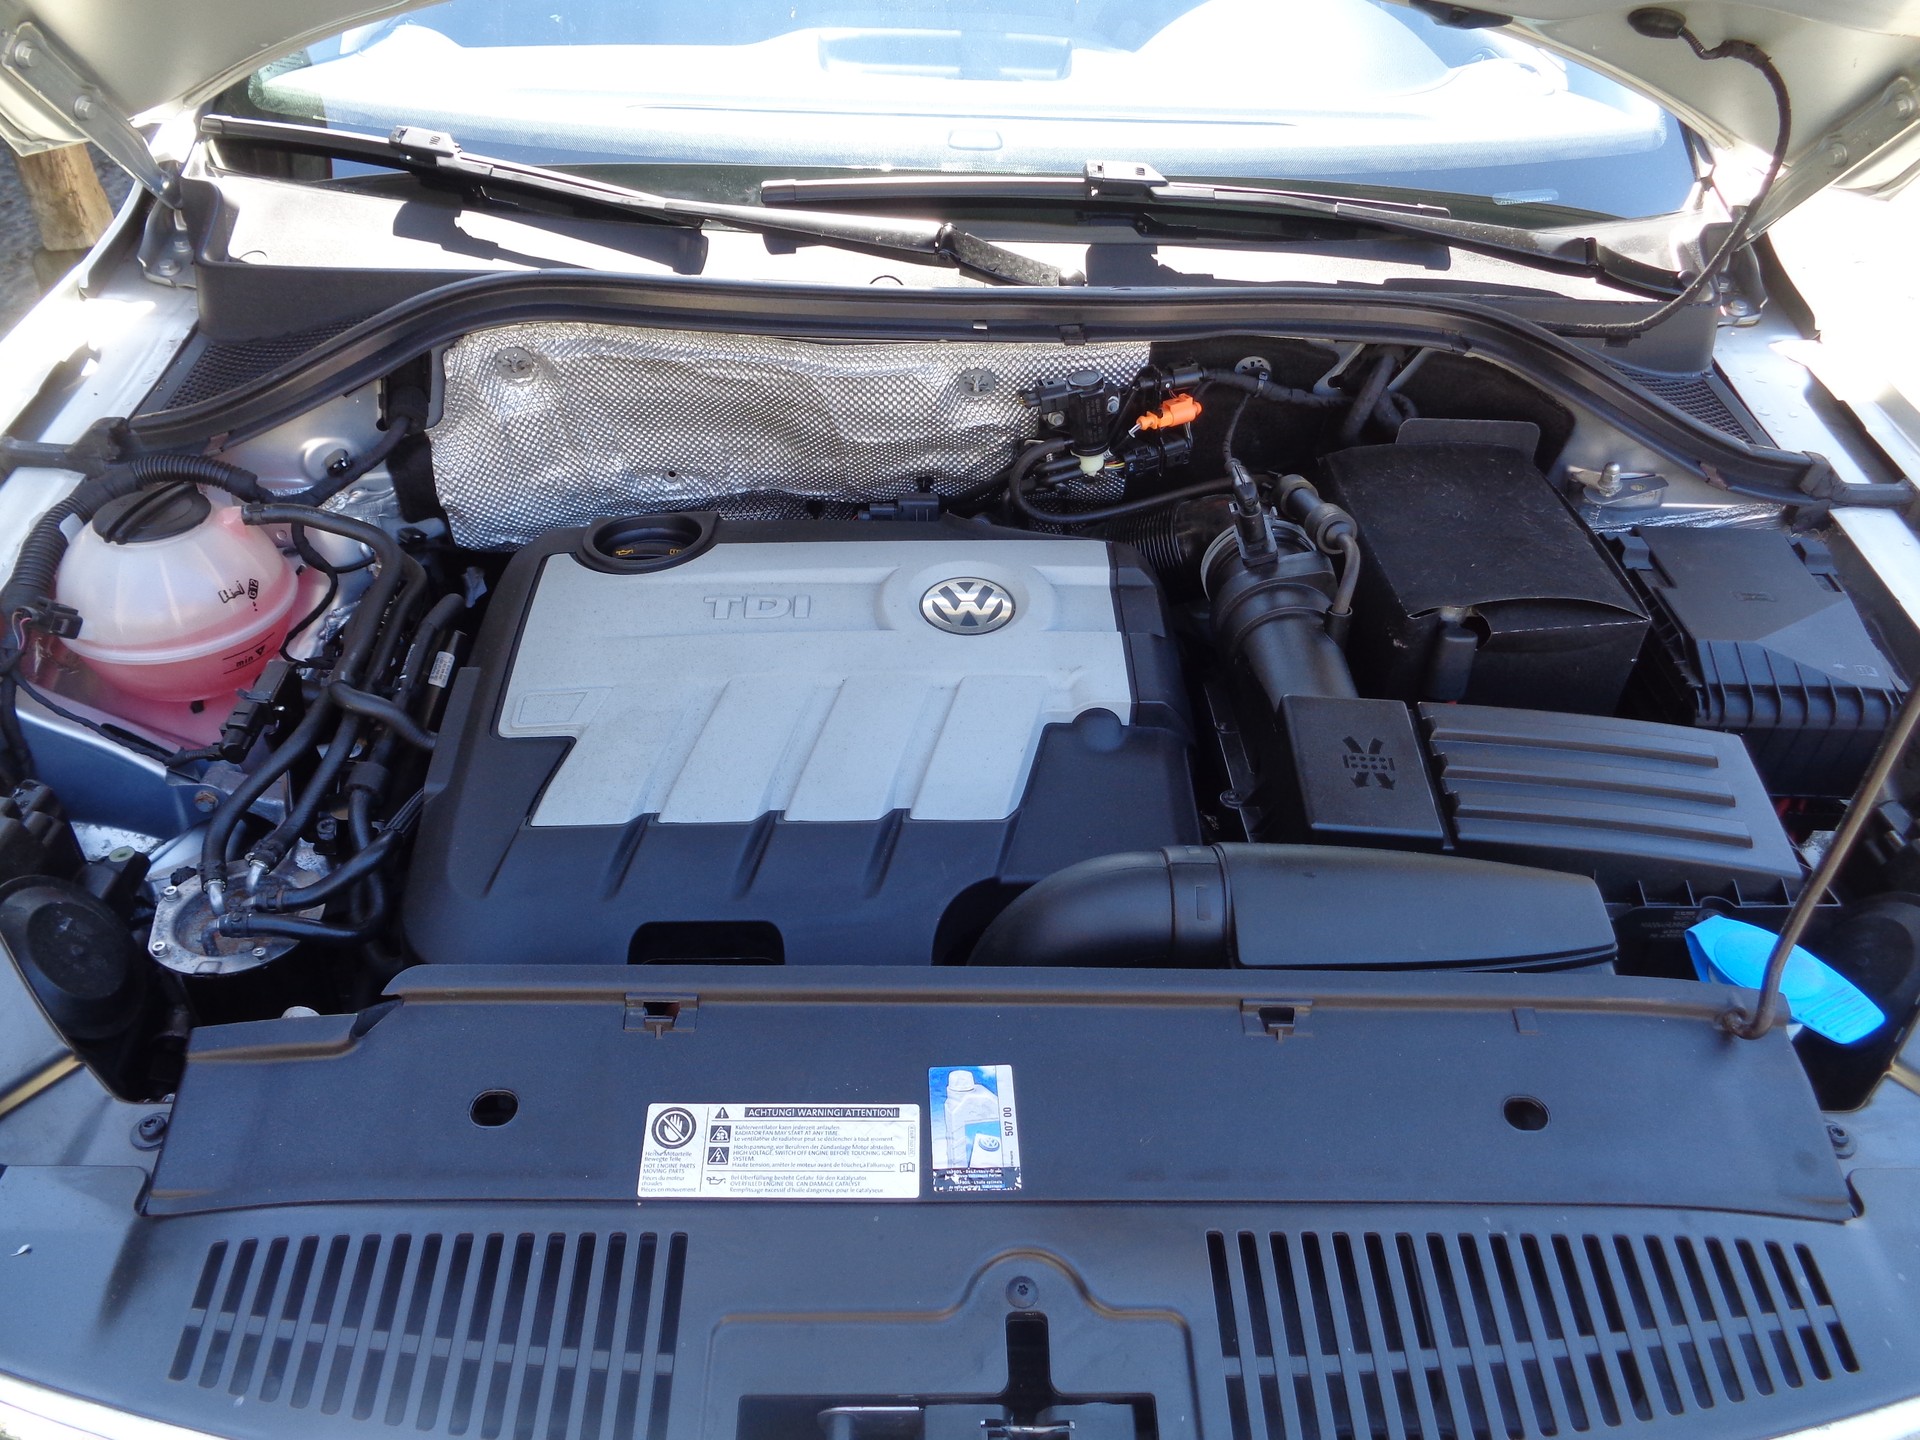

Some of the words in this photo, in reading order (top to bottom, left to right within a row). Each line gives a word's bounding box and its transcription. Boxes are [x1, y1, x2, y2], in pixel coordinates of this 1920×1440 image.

[703, 594, 812, 620] TDI
[236, 656, 253, 667] min
[748, 1108, 795, 1117] ACHTUNG!
[797, 1108, 843, 1117] WARNING!
[845, 1108, 896, 1117] ATTENTION!
[1003, 1107, 1012, 1118] 00
[1004, 1121, 1014, 1137] 507
